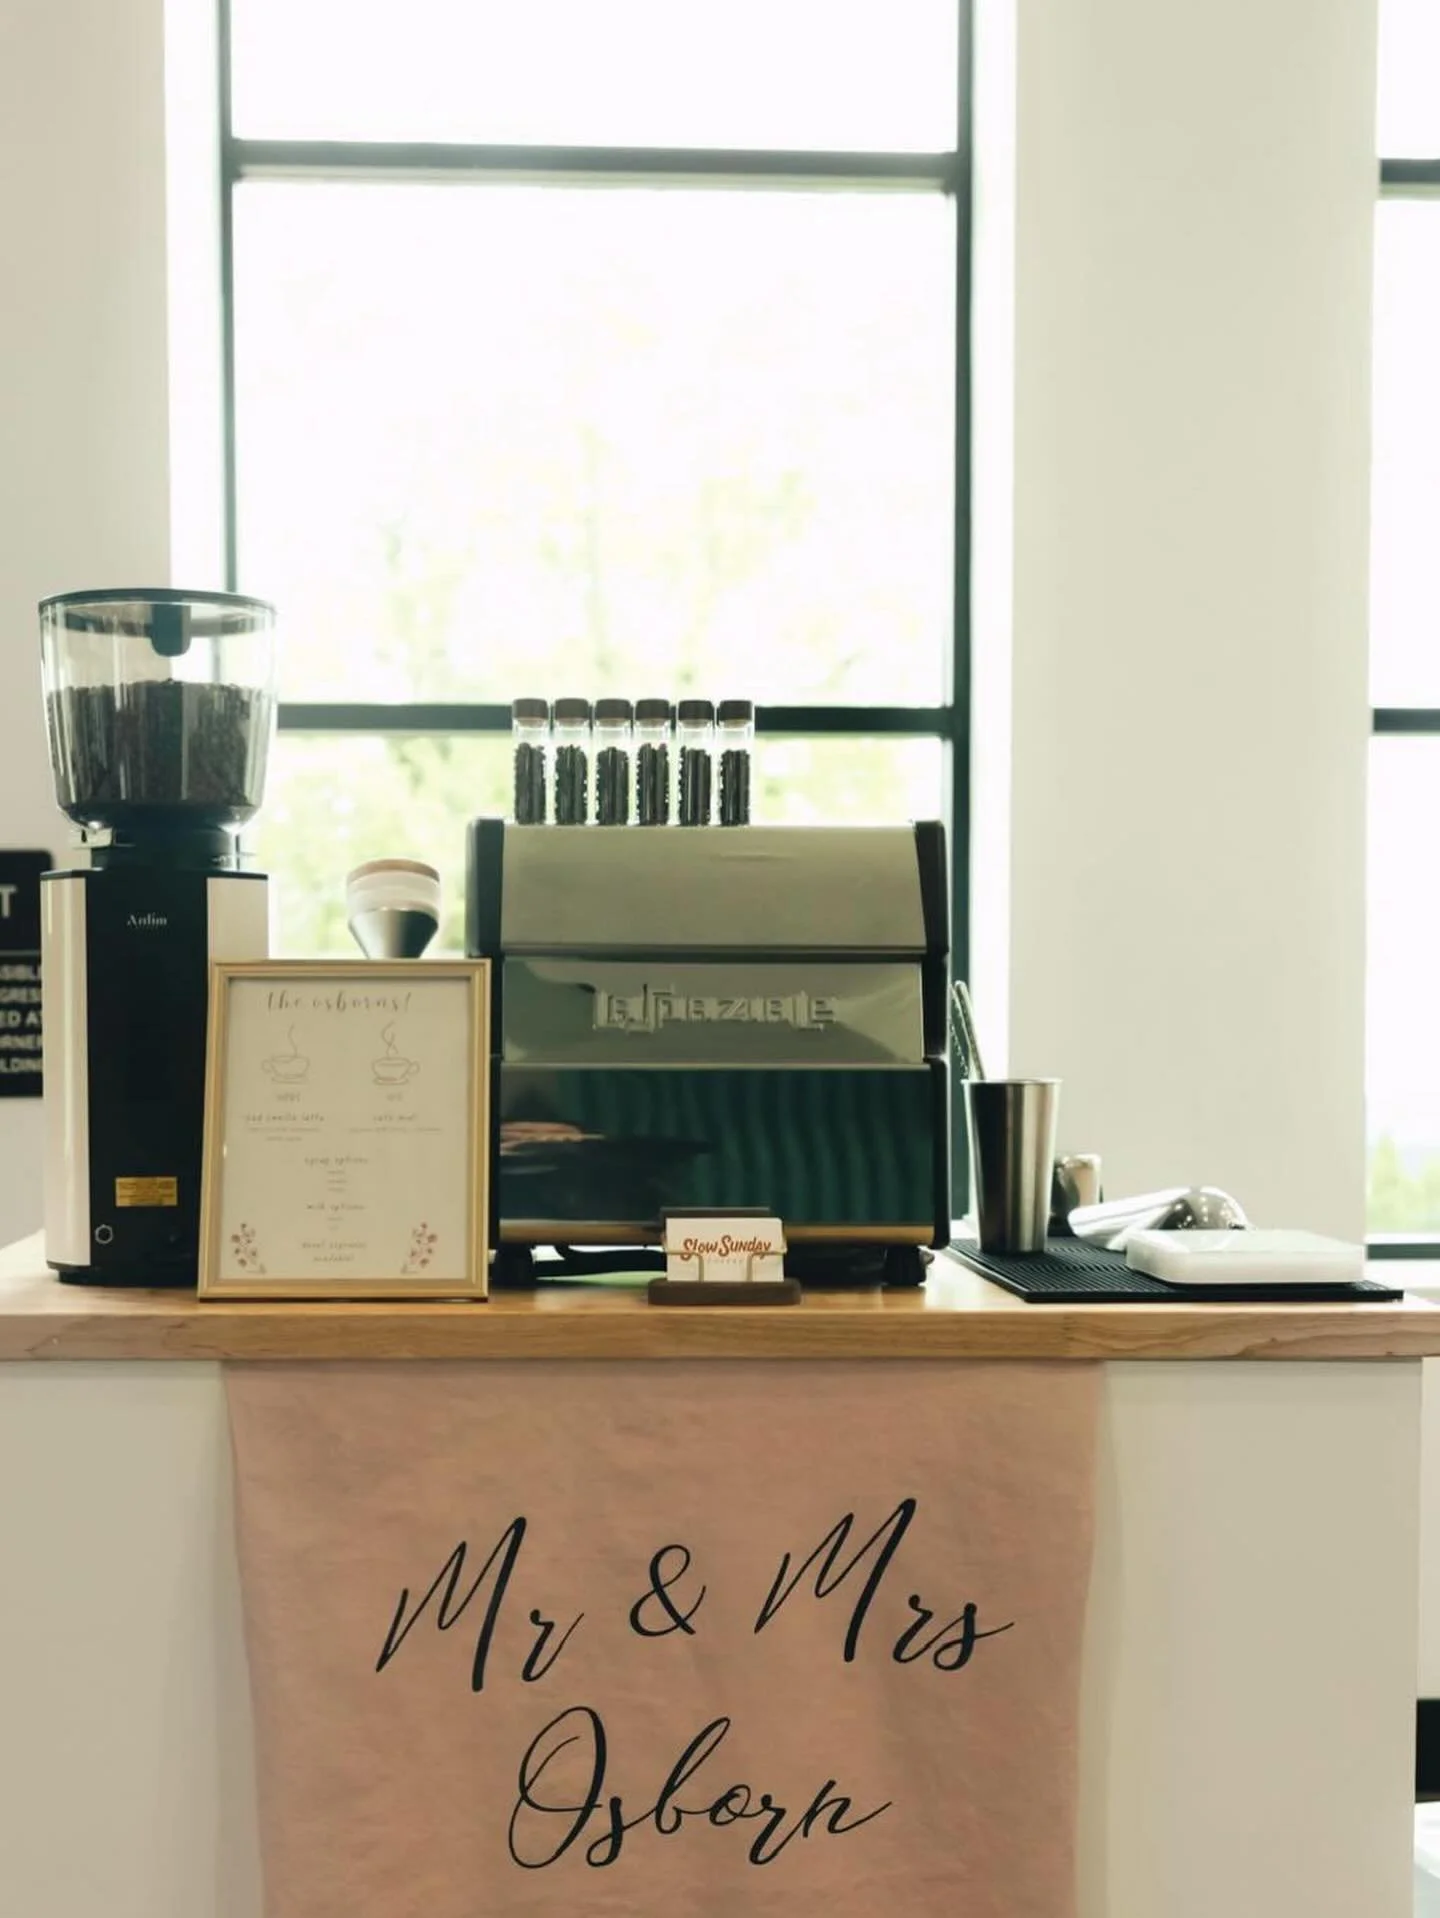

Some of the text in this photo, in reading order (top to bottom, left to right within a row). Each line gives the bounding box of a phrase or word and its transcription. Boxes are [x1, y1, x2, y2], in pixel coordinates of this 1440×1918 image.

[266, 990, 304, 1013] the
[680, 1235, 772, 1262] Slow Sunday
[374, 1497, 1016, 1694] Mr & Mrs
[507, 1705, 893, 1870] Osborn
